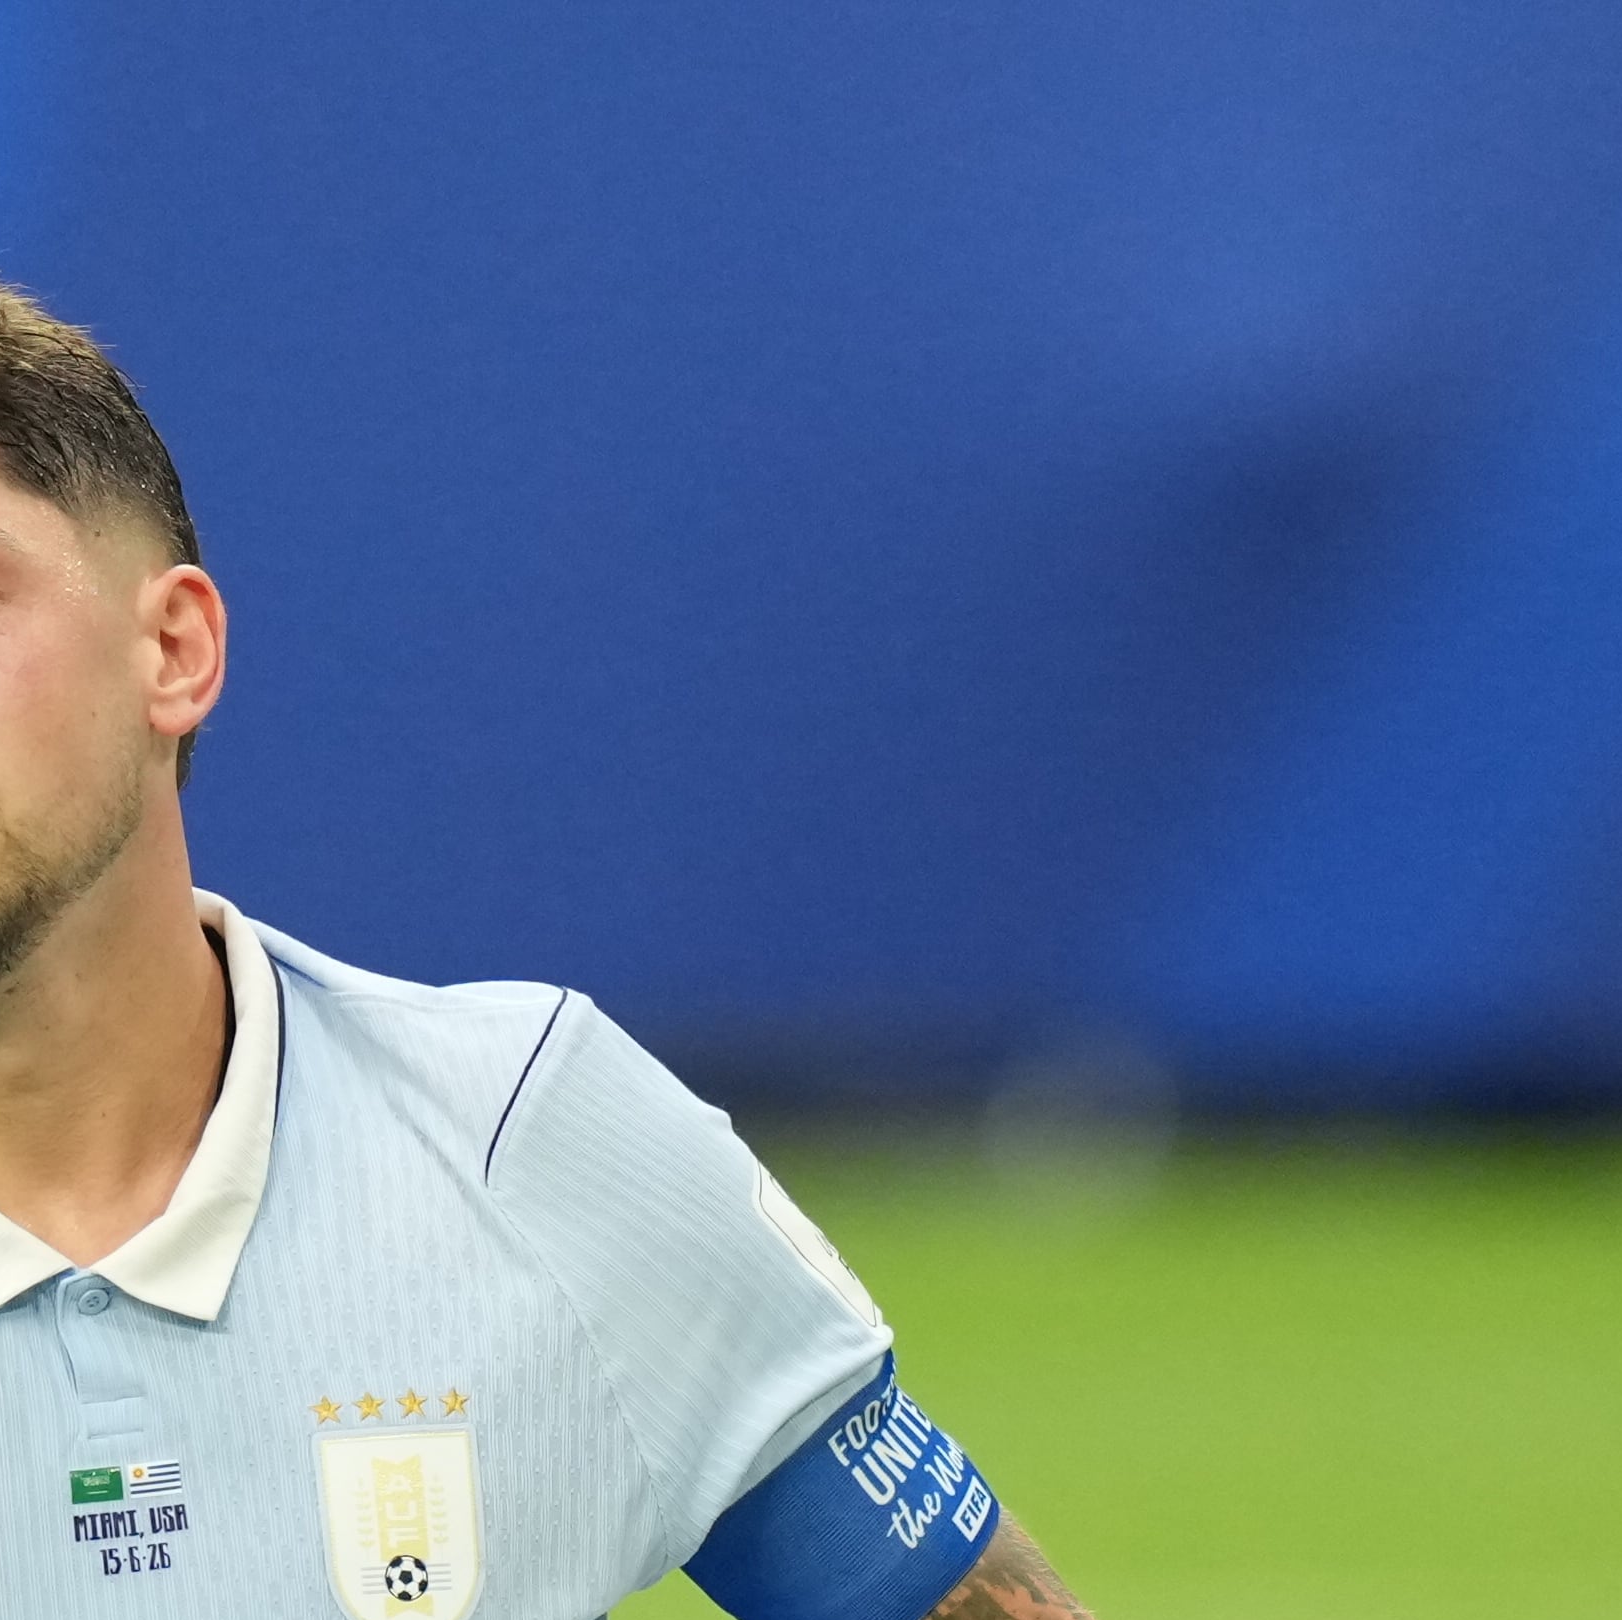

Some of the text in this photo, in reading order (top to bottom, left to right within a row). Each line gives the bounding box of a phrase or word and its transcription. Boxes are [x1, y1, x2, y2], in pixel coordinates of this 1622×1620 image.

[851, 1388, 933, 1506] UNITE
[73, 1503, 189, 1542] MIAMI, USA
[886, 1492, 942, 1550] the
